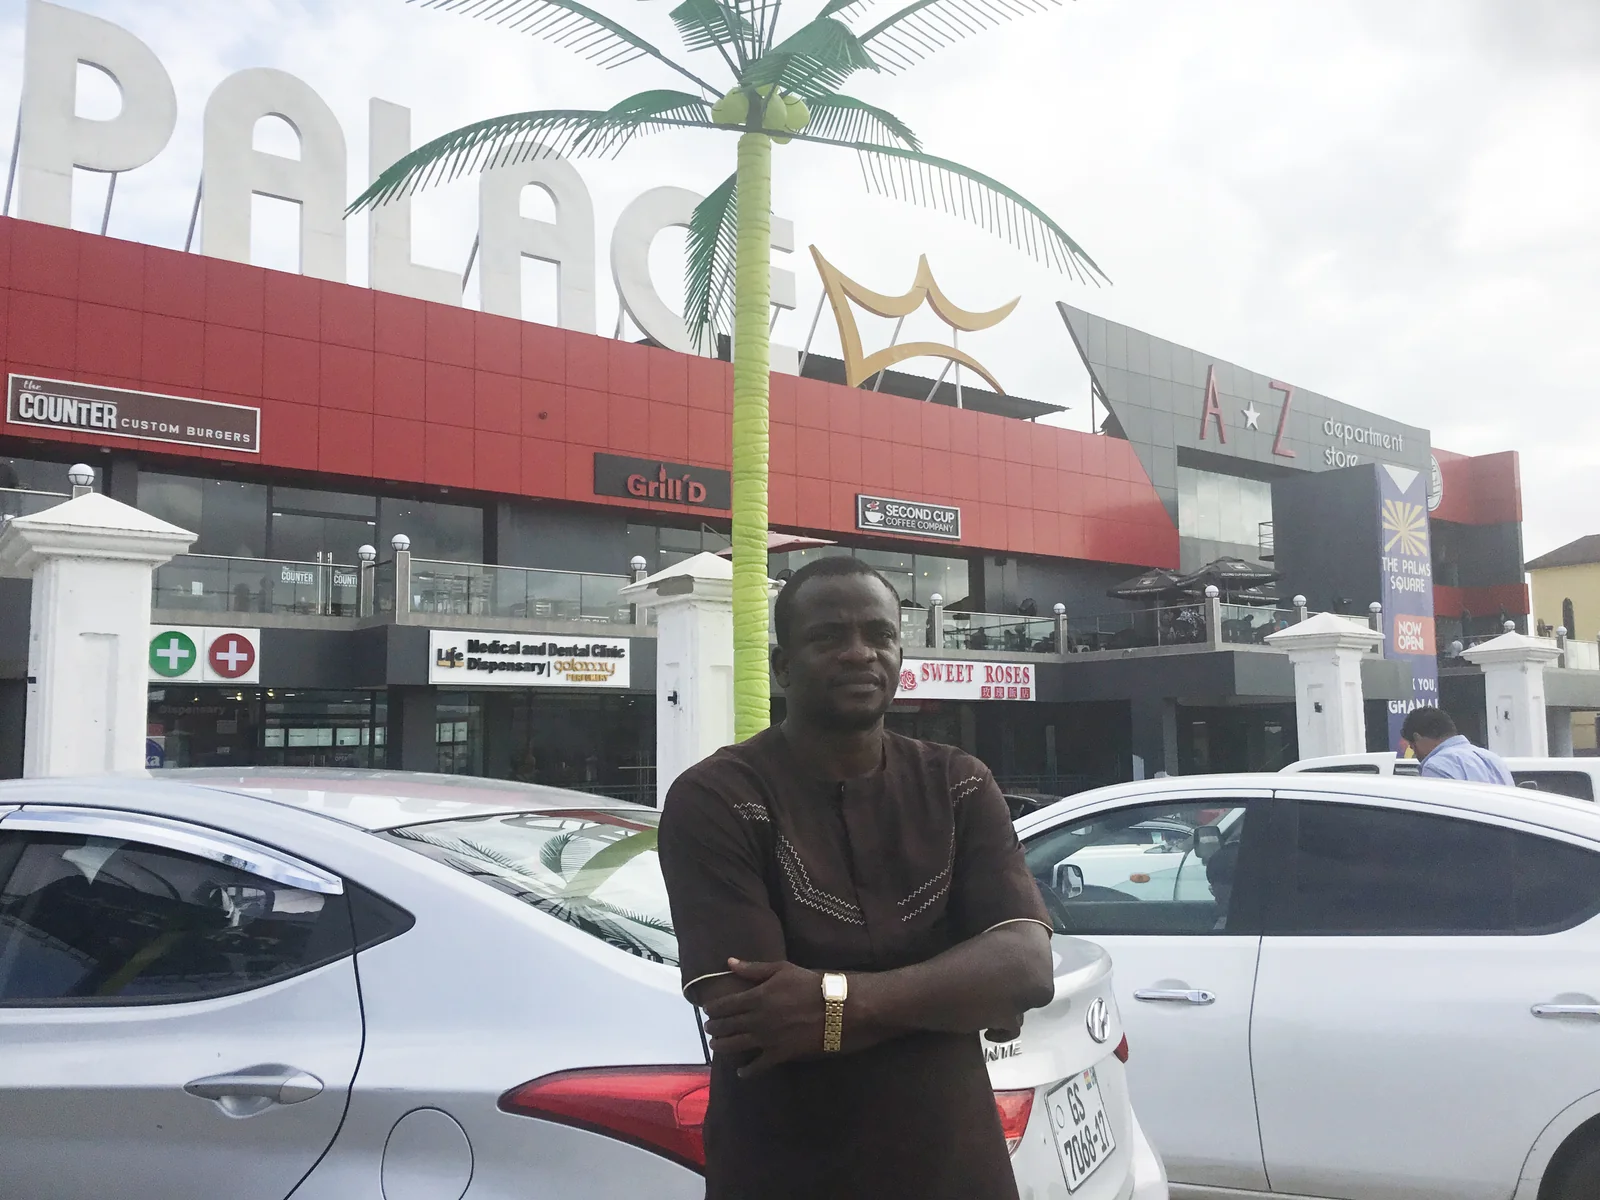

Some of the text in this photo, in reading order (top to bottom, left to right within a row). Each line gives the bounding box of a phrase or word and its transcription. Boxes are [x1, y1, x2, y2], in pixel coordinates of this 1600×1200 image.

[19, 393, 250, 443] COUNTER CUSTOM BURGERS
[1199, 364, 1296, 458] A Z
[1324, 417, 1403, 452] department
[885, 504, 955, 523] SECOND CUP
[885, 516, 954, 532] COFFEE COMPANY
[1382, 557, 1431, 577] THE PALMS
[281, 571, 314, 583] COUNTER
[334, 575, 357, 586] COUNT
[1390, 575, 1425, 593] SQUARE
[1398, 621, 1422, 635] NOW
[437, 647, 464, 668] Life
[467, 639, 625, 658] Medical and Dental Clinic
[467, 657, 545, 674] Dispensary
[921, 663, 1030, 684] SWEET ROSES
[1066, 1082, 1086, 1126] GS
[1063, 1109, 1111, 1181] 7068-17
